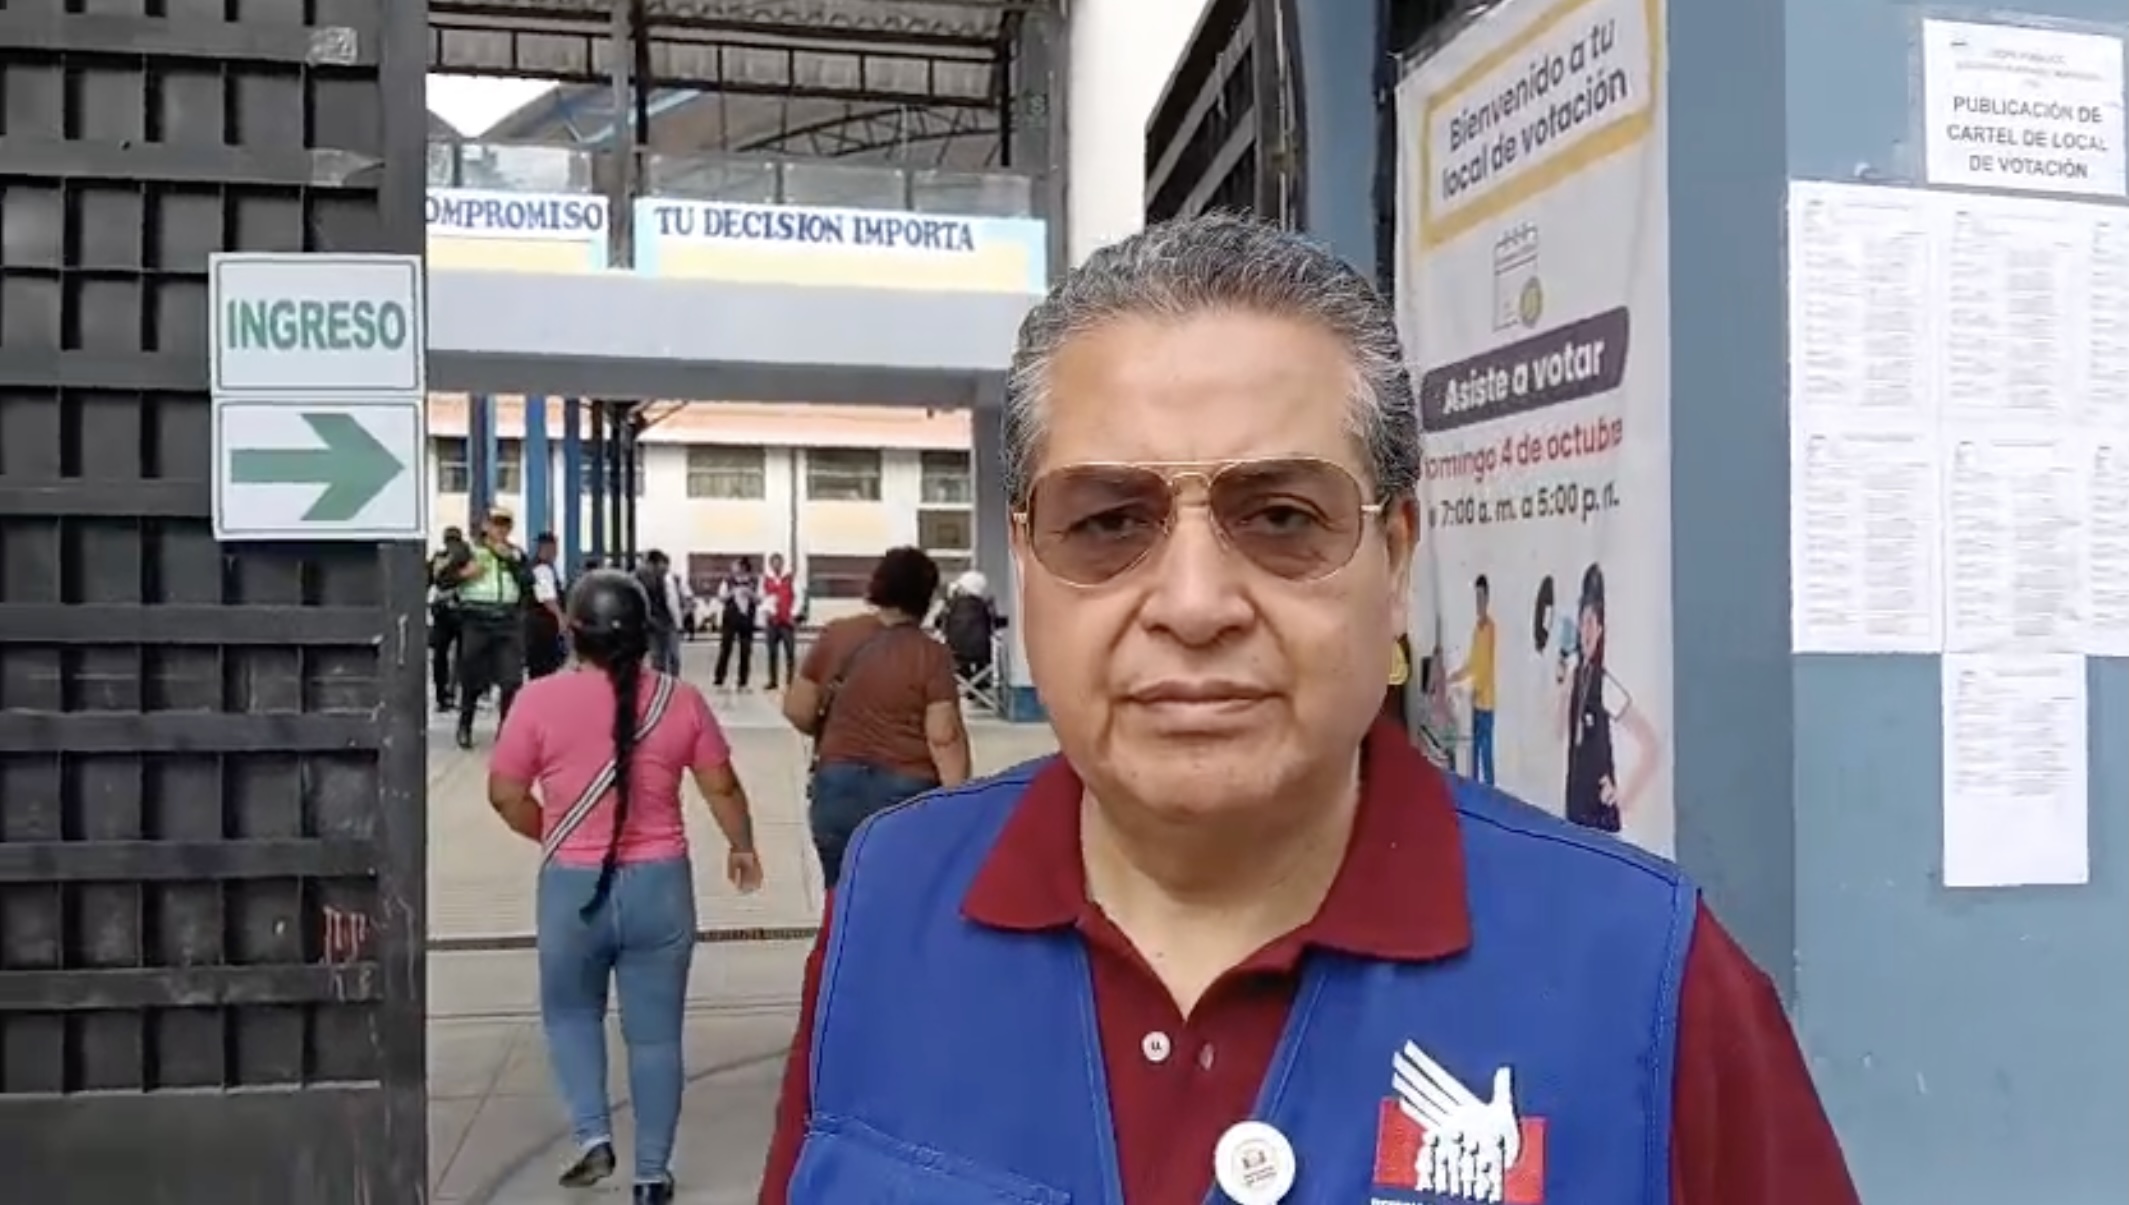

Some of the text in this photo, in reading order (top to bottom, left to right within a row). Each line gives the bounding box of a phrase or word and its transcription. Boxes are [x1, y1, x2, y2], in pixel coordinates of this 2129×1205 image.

[1450, 18, 1615, 152] Bienvenido a tu
[1953, 96, 2103, 123] PUBLICACIÓN DE
[1442, 67, 1627, 199] local de votación
[1946, 124, 2109, 152] CARTEL DE LOCAL
[1969, 154, 2089, 179] DE VOTACIÓN
[425, 196, 603, 231] OMPROMISO
[655, 206, 975, 251] TU DECISION IMPORTA
[226, 299, 407, 351] INGRESO
[1443, 341, 1605, 415] Asiste a votar
[1502, 436, 1512, 467] 4
[1517, 432, 1541, 466] de
[1521, 497, 1533, 519] a
[1538, 484, 1578, 517] 5:00
[1581, 489, 1600, 525] p.
